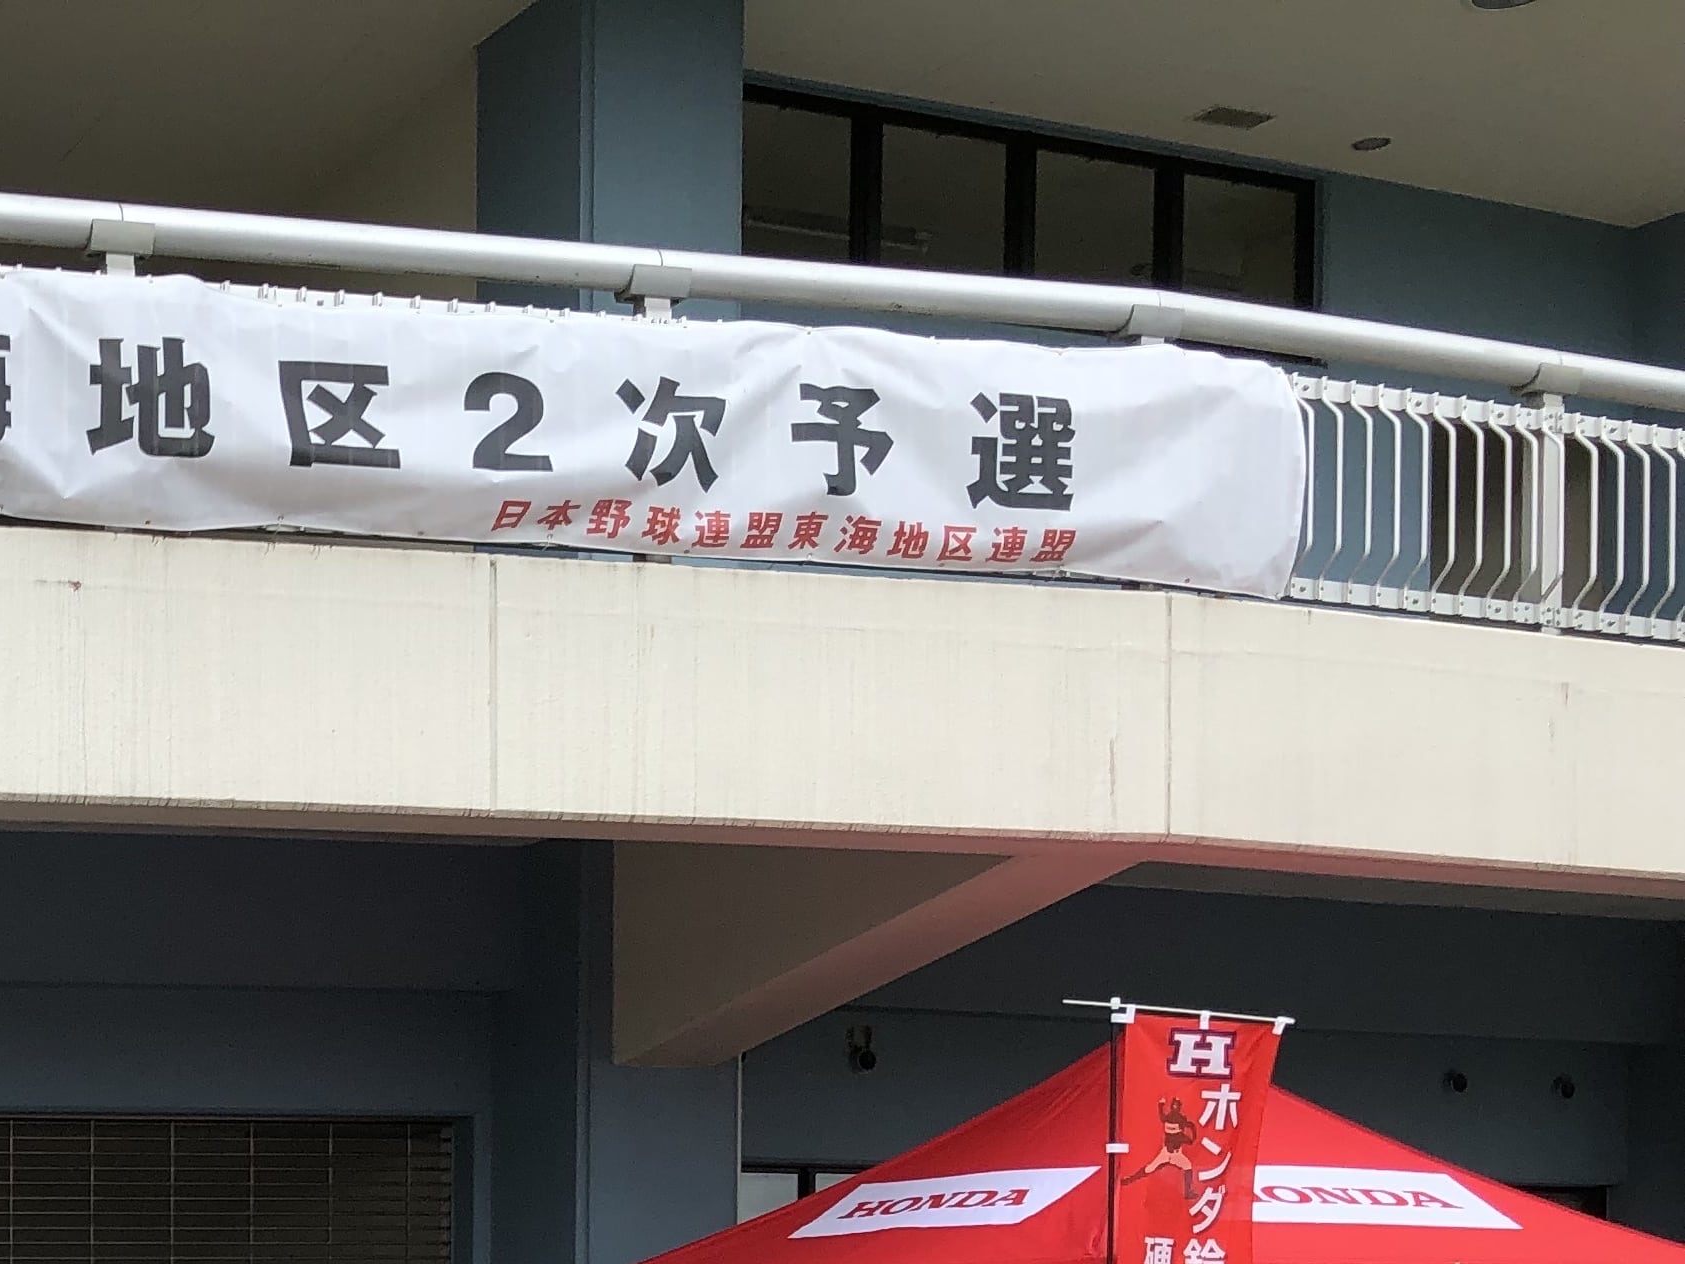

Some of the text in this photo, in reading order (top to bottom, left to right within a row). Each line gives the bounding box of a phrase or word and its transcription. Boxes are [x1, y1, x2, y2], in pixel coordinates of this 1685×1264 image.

[491, 498, 1077, 563] 日本野球連盟東海地区連盟
[1168, 1031, 1234, 1078] H
[836, 1188, 1030, 1220] HONDA
[1256, 1184, 1464, 1210] ONDA
